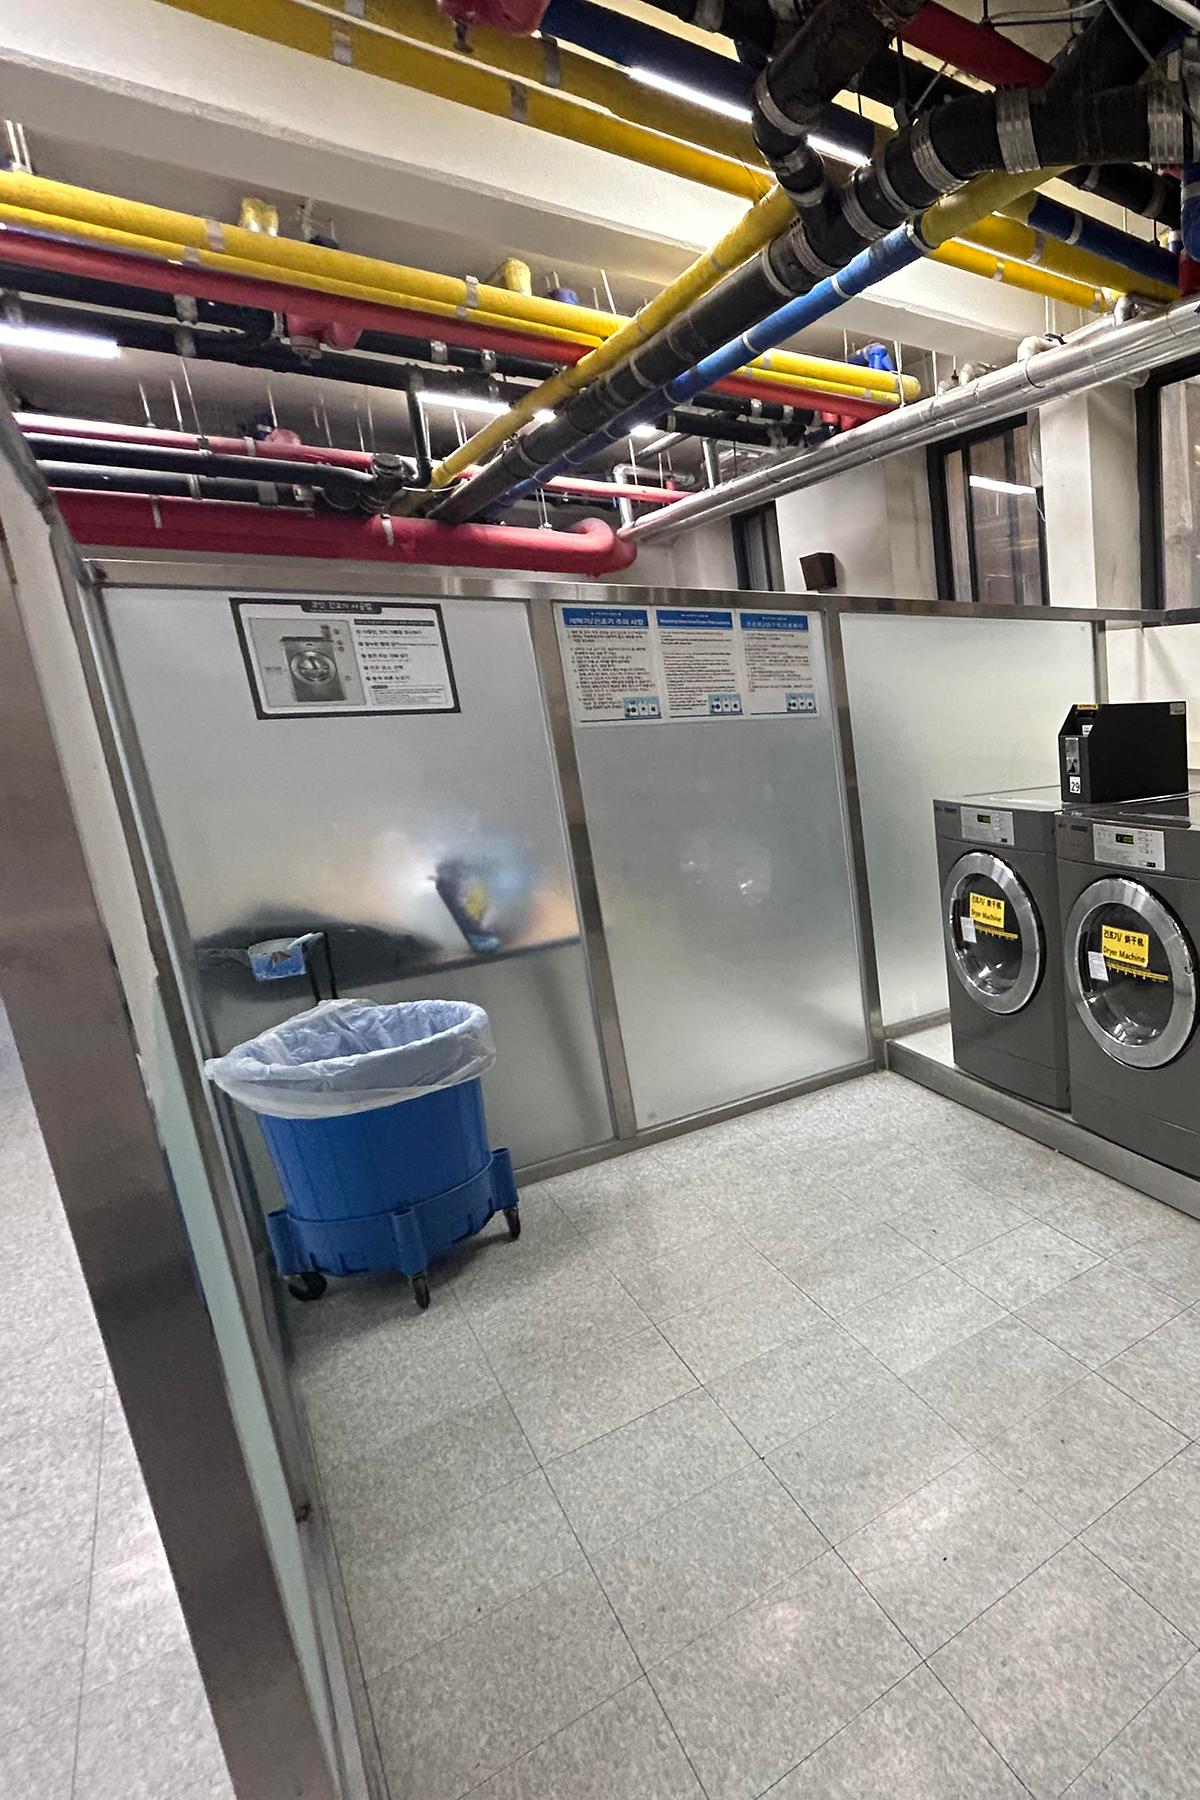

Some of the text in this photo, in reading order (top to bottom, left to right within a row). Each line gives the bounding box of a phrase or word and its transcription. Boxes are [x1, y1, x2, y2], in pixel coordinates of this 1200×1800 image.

[1071, 781, 1080, 792] 29
[1103, 946, 1146, 963] Dryer Machine
